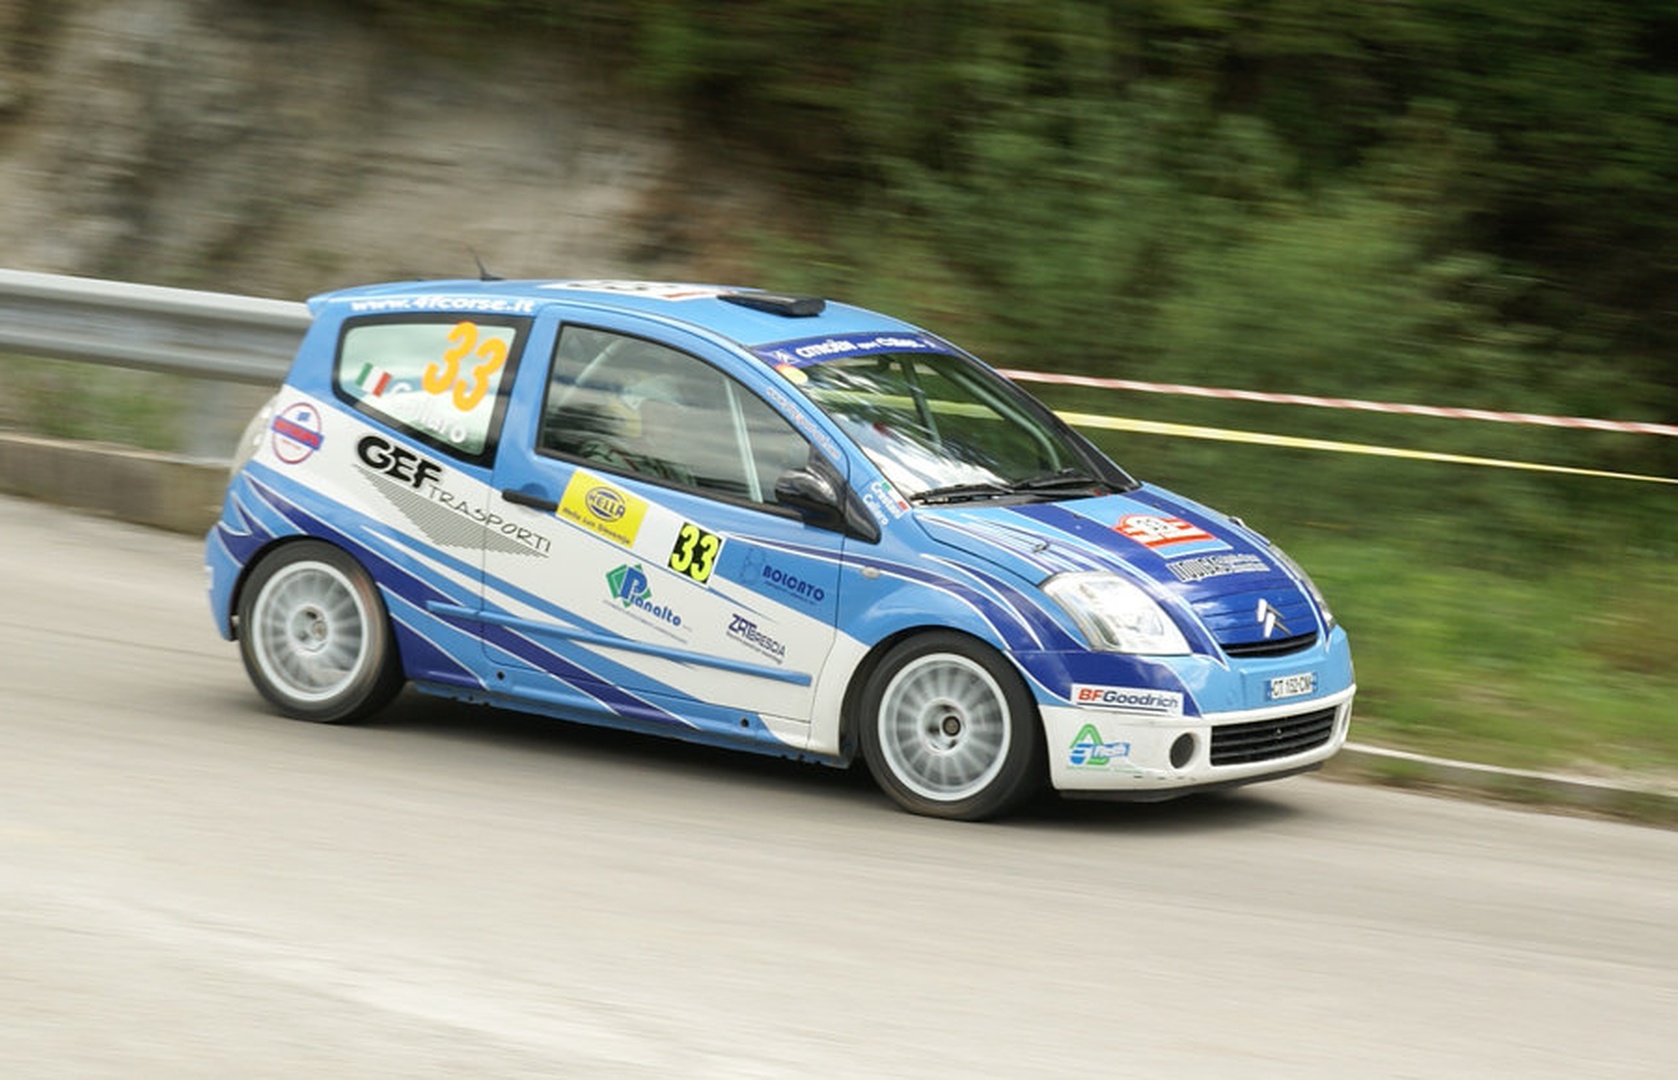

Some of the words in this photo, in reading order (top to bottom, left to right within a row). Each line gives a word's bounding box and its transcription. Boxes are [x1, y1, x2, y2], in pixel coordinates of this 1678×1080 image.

[421, 321, 509, 412] 33
[357, 435, 442, 489] GEF
[428, 485, 551, 552] TRASPORTI
[670, 524, 721, 582] 33
[619, 567, 682, 627] Pianalto
[1078, 688, 1178, 709] BFGoodrich
